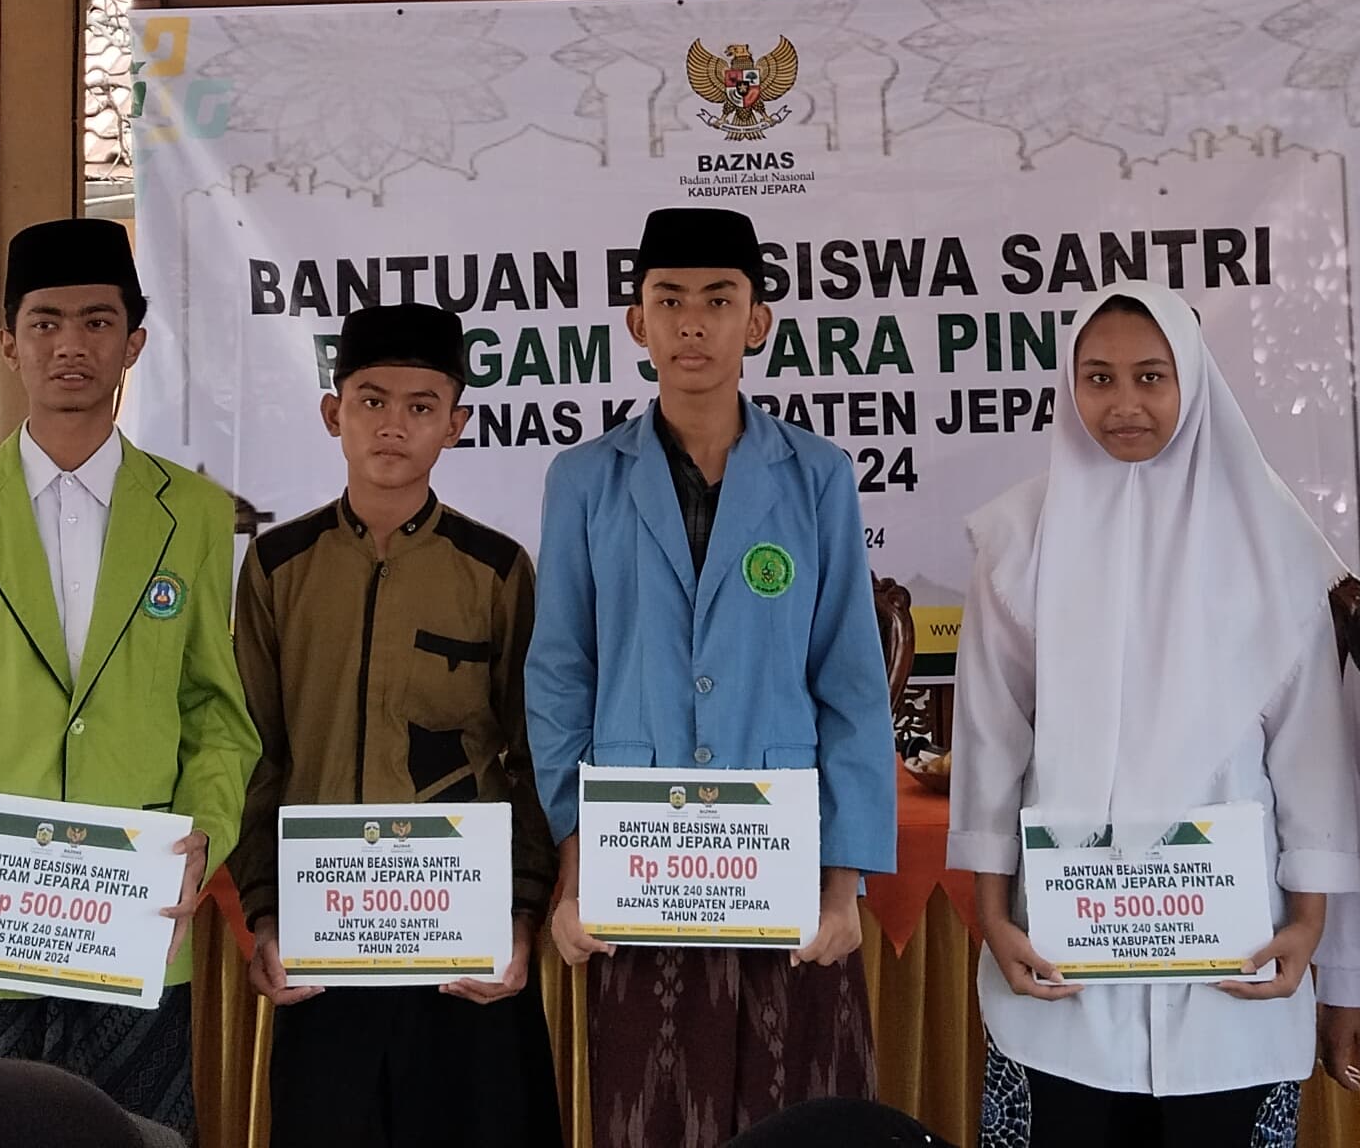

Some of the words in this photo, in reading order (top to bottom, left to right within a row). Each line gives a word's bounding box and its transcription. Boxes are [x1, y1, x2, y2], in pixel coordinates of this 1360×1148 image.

[698, 152, 794, 172] BAZNAS
[680, 176, 710, 185] Badan
[713, 174, 738, 184] Amil
[740, 172, 769, 183] Zakat
[772, 171, 815, 182] Nasional
[688, 186, 757, 197] KABUPATEN
[761, 184, 806, 195] JEPARA
[248, 250, 579, 317] BANTUAN
[606, 235, 979, 308] BSISWA
[1001, 226, 1272, 295] SANTRI
[313, 324, 612, 389] PGAM
[935, 386, 1056, 435] JEPA
[620, 821, 669, 833] BANTUAN
[673, 822, 726, 834] BEASISWA
[730, 823, 768, 835] SANTRI
[600, 835, 672, 848] PROGRAM
[677, 836, 731, 849] JEPARA
[737, 837, 790, 850] PINTAR
[315, 858, 364, 868] BANTUAN
[368, 857, 419, 868] BEASISWA
[422, 856, 460, 867] SANTRI
[630, 855, 658, 883] Rp
[667, 855, 758, 879] 500.000
[34, 859, 88, 877] BEASISWA
[90, 866, 130, 881] SANTRI
[297, 871, 366, 883] PROGRAM
[371, 870, 425, 882] JEPARA
[430, 870, 481, 882] PINTAR
[1064, 866, 1113, 877] BANTUAN
[1117, 864, 1170, 876] BEASISWA
[1173, 863, 1212, 874] SANTRI
[34, 875, 90, 892] JEPARA
[95, 883, 149, 899] PINTAR
[1046, 878, 1117, 891] PROGRAM
[1121, 877, 1176, 889] JEPARA
[1182, 875, 1235, 887] PINTAR
[642, 885, 679, 896] UNTUK
[683, 885, 702, 896] 240
[706, 886, 746, 896] SANTRI
[20, 892, 112, 924] 500.000
[326, 890, 354, 916] Rp
[363, 889, 450, 911] 500.000
[617, 898, 659, 908] BAZNAS
[663, 899, 726, 909] KABUPATEN
[729, 900, 770, 910] JEPARA
[1077, 896, 1106, 923] Rp
[1114, 894, 1204, 917] 500.000
[661, 911, 697, 921] TAHUN
[701, 912, 725, 922] 2024
[338, 919, 375, 929] UNTUK
[379, 919, 397, 929] 240
[400, 919, 439, 928] SANTRI
[1090, 924, 1129, 934] UNTUK
[1132, 923, 1151, 933] 240
[1154, 923, 1194, 932] SANTRI
[33, 924, 52, 935] 240
[55, 927, 95, 941] SANTRI
[315, 931, 355, 941] BAZNAS
[359, 931, 419, 941] KABUPATEN
[423, 931, 462, 941] JEPARA
[8, 934, 73, 951] KABUPATEN
[76, 944, 116, 957] JEPARA
[1067, 937, 1109, 947] BAZNAS
[1113, 936, 1175, 946] KABUPATEN
[1179, 934, 1219, 944] JEPARA
[5, 947, 41, 960] TAHUN
[44, 952, 69, 963] 2024
[357, 944, 392, 953] TAHUN
[396, 944, 419, 953] 2024
[1112, 948, 1149, 958] TAHUN
[1152, 947, 1176, 957] 2024
